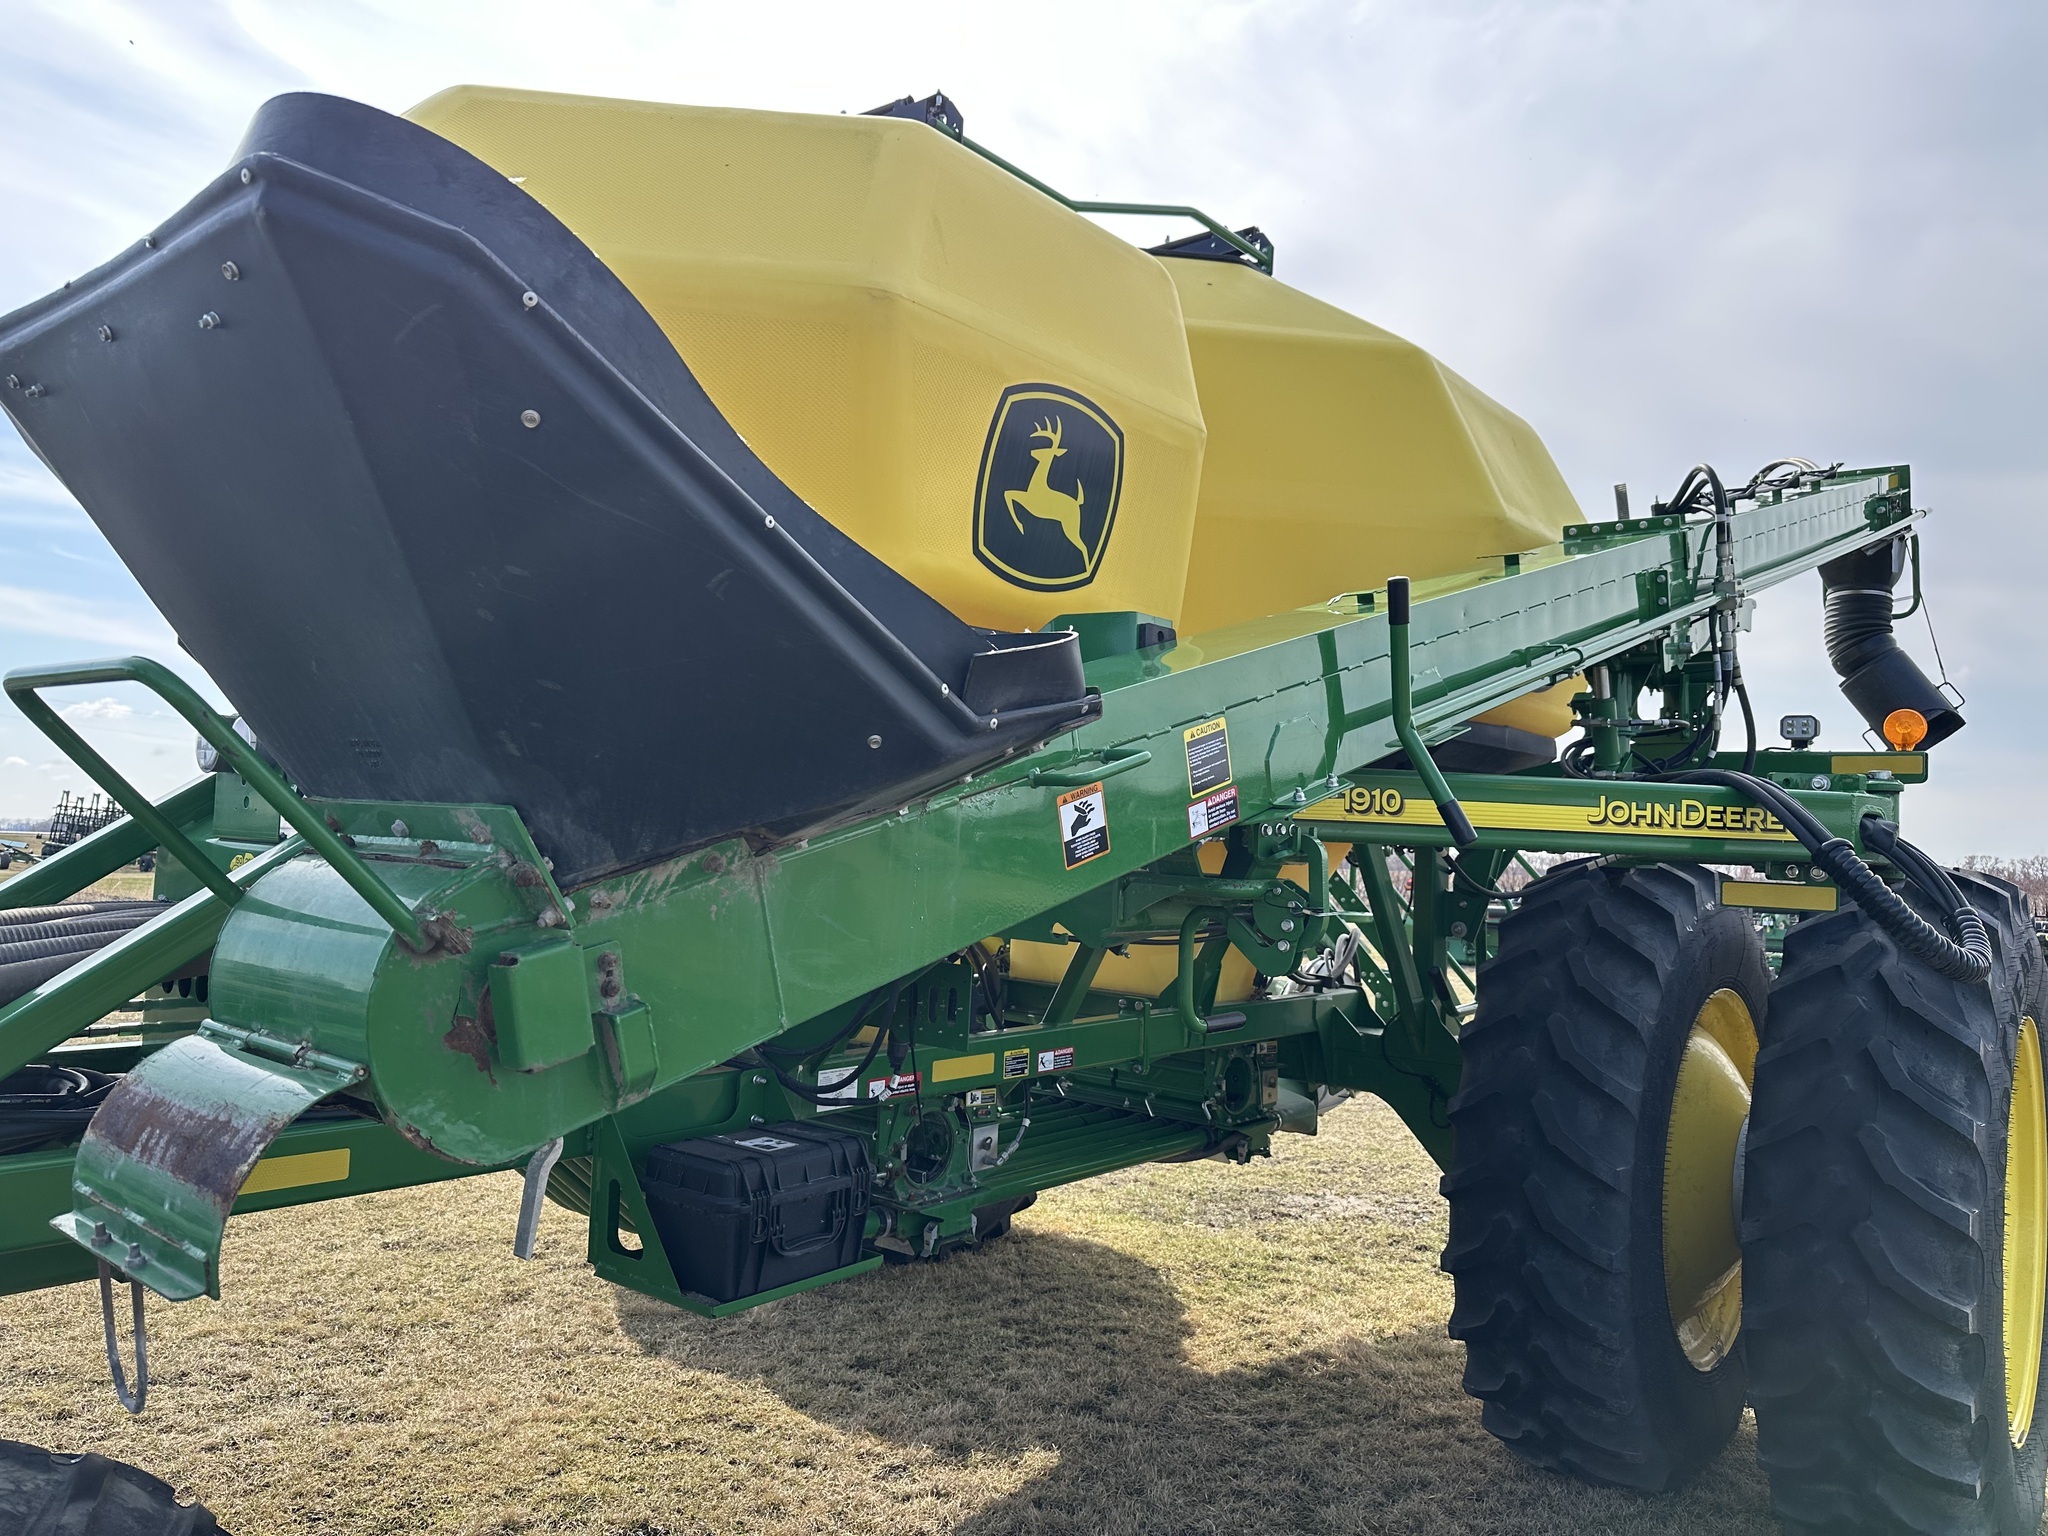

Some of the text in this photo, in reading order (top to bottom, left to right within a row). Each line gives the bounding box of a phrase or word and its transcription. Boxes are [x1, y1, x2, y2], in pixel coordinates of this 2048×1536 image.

[1195, 721, 1221, 737] CAUTION
[1069, 784, 1099, 801] WARNING
[1211, 788, 1236, 805] DANGER
[1342, 786, 1403, 816] 1910
[1587, 795, 1786, 832] JOHN DEERE
